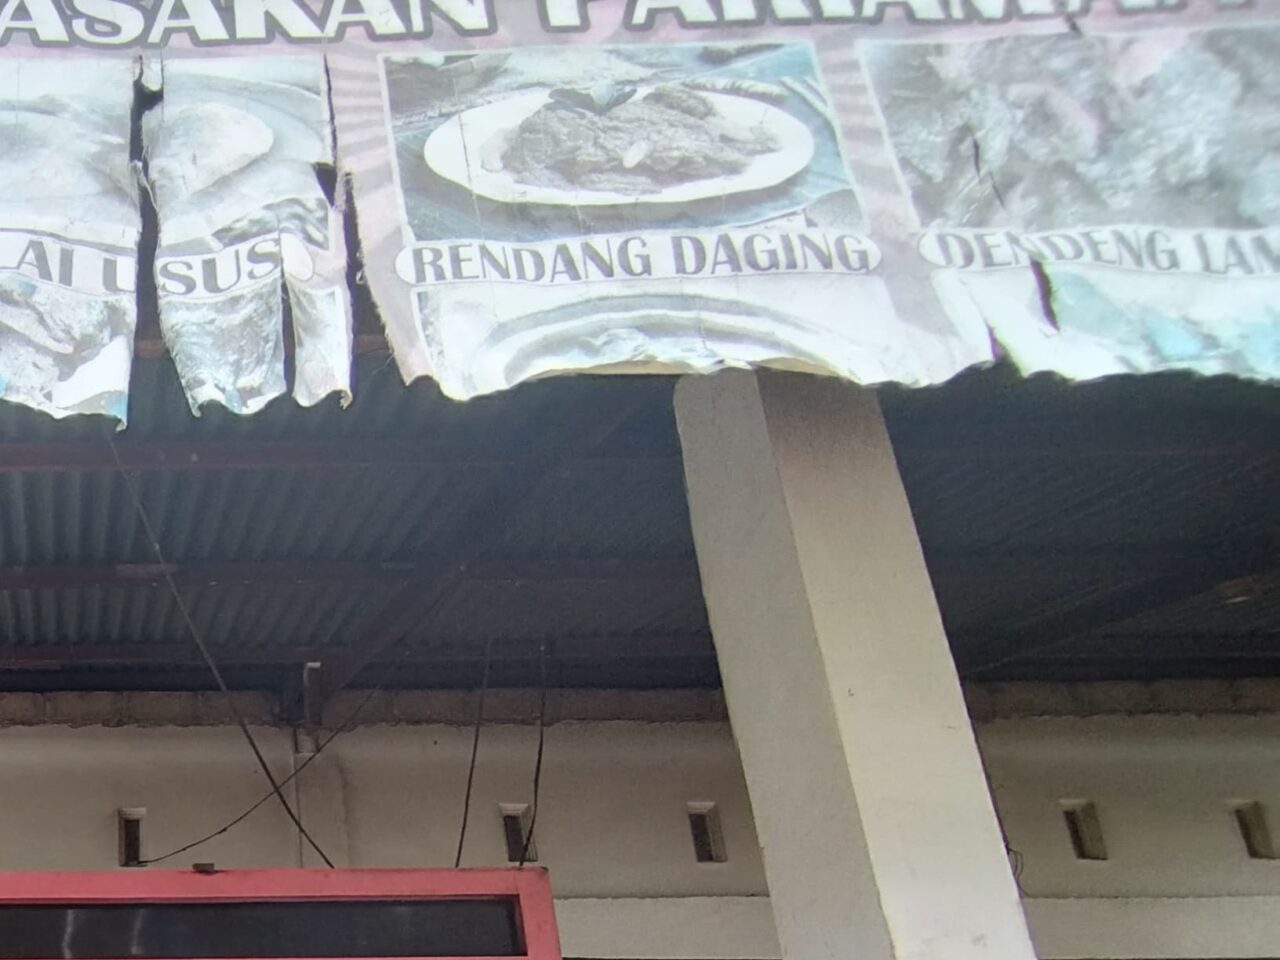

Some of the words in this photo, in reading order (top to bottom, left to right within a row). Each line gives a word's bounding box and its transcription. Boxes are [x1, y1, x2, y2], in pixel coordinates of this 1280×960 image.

[101, 235, 282, 297] USUS
[411, 235, 652, 285] RENDANG
[669, 233, 869, 277] DAGING
[934, 228, 1181, 271] DENDENG
